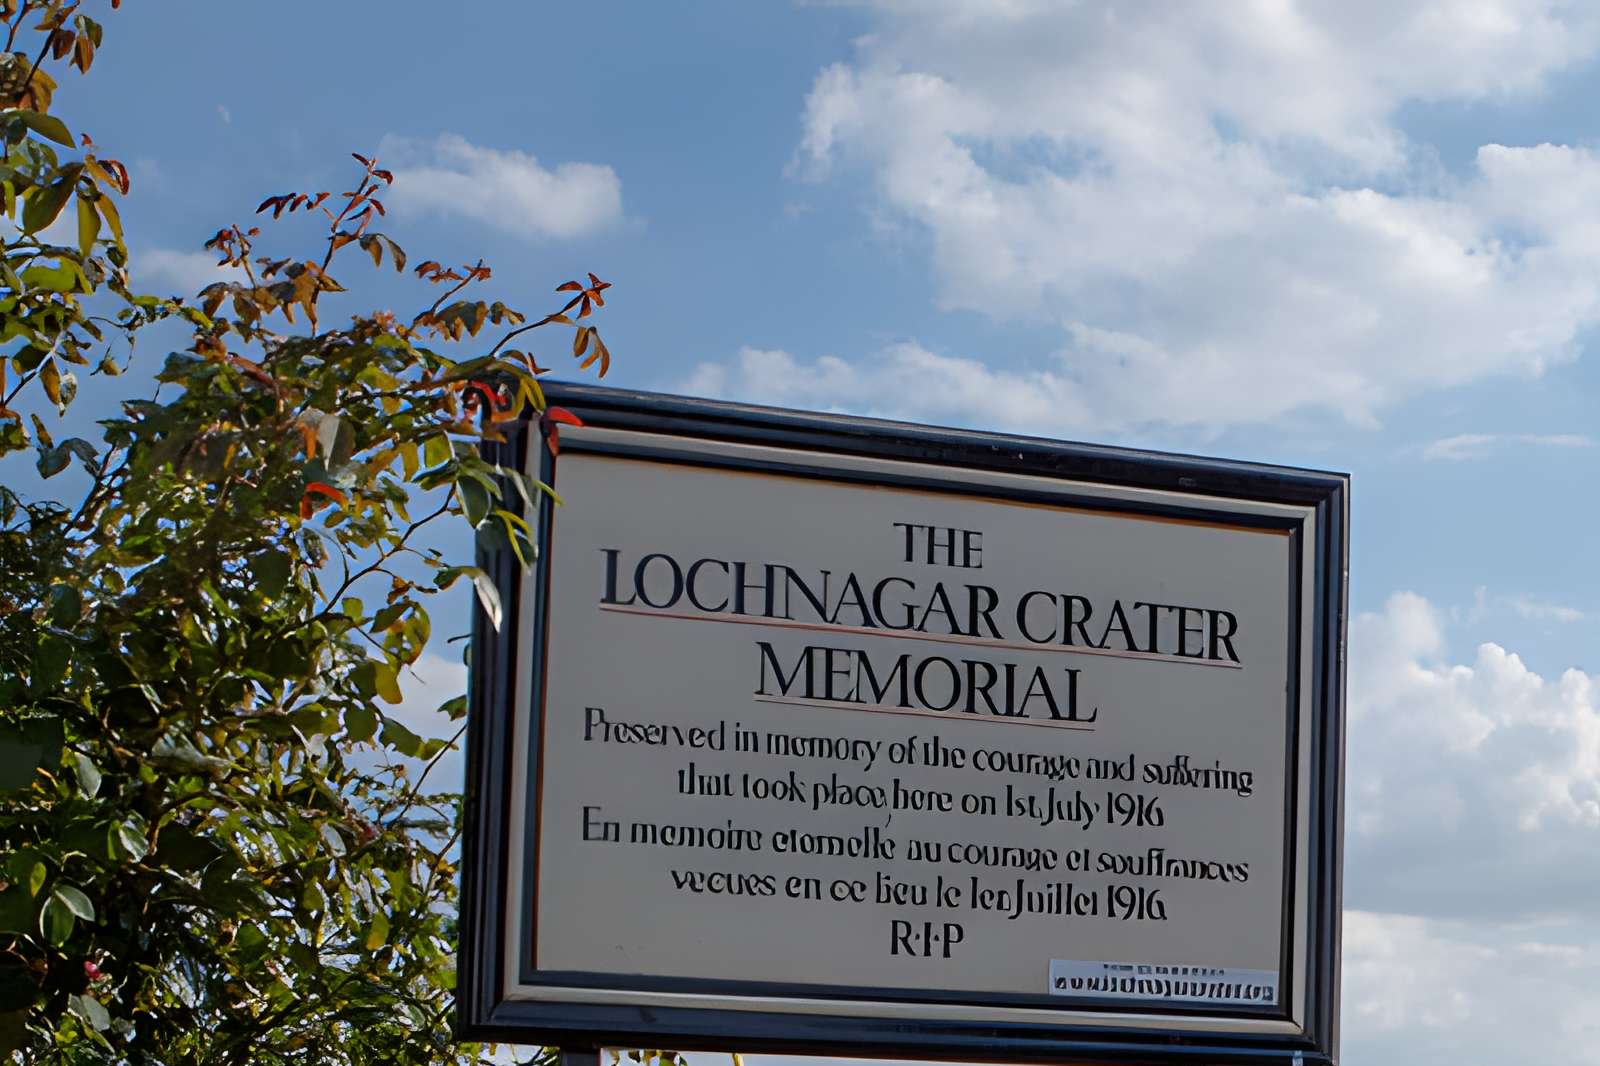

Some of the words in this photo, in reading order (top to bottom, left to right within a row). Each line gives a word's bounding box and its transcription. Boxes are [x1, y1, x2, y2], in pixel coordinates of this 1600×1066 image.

[893, 522, 983, 569] THE
[600, 548, 1005, 640] LOCHNAGAR
[1016, 591, 1240, 664] CRATER
[754, 642, 1098, 722] MEMORIAL
[584, 707, 725, 751] Preserved
[735, 722, 758, 752] in
[766, 733, 881, 771] memory
[888, 735, 917, 765] of
[923, 736, 965, 768] the
[972, 749, 1079, 781] courage
[1086, 754, 1135, 781] and
[1142, 755, 1253, 797] suffering
[678, 762, 734, 796] that
[743, 771, 806, 803] took
[893, 778, 952, 812] here
[961, 794, 996, 815] on
[1041, 787, 1099, 830] July
[1107, 792, 1164, 827] 1916
[582, 806, 620, 842] En
[907, 840, 941, 863] au
[949, 844, 1057, 872] courage
[1066, 849, 1089, 872] et
[785, 878, 821, 901] en
[830, 880, 866, 902] ce
[876, 872, 927, 905] lieu
[936, 876, 960, 908] le
[1008, 879, 1098, 919] Juillet
[1107, 885, 1167, 920] 1916
